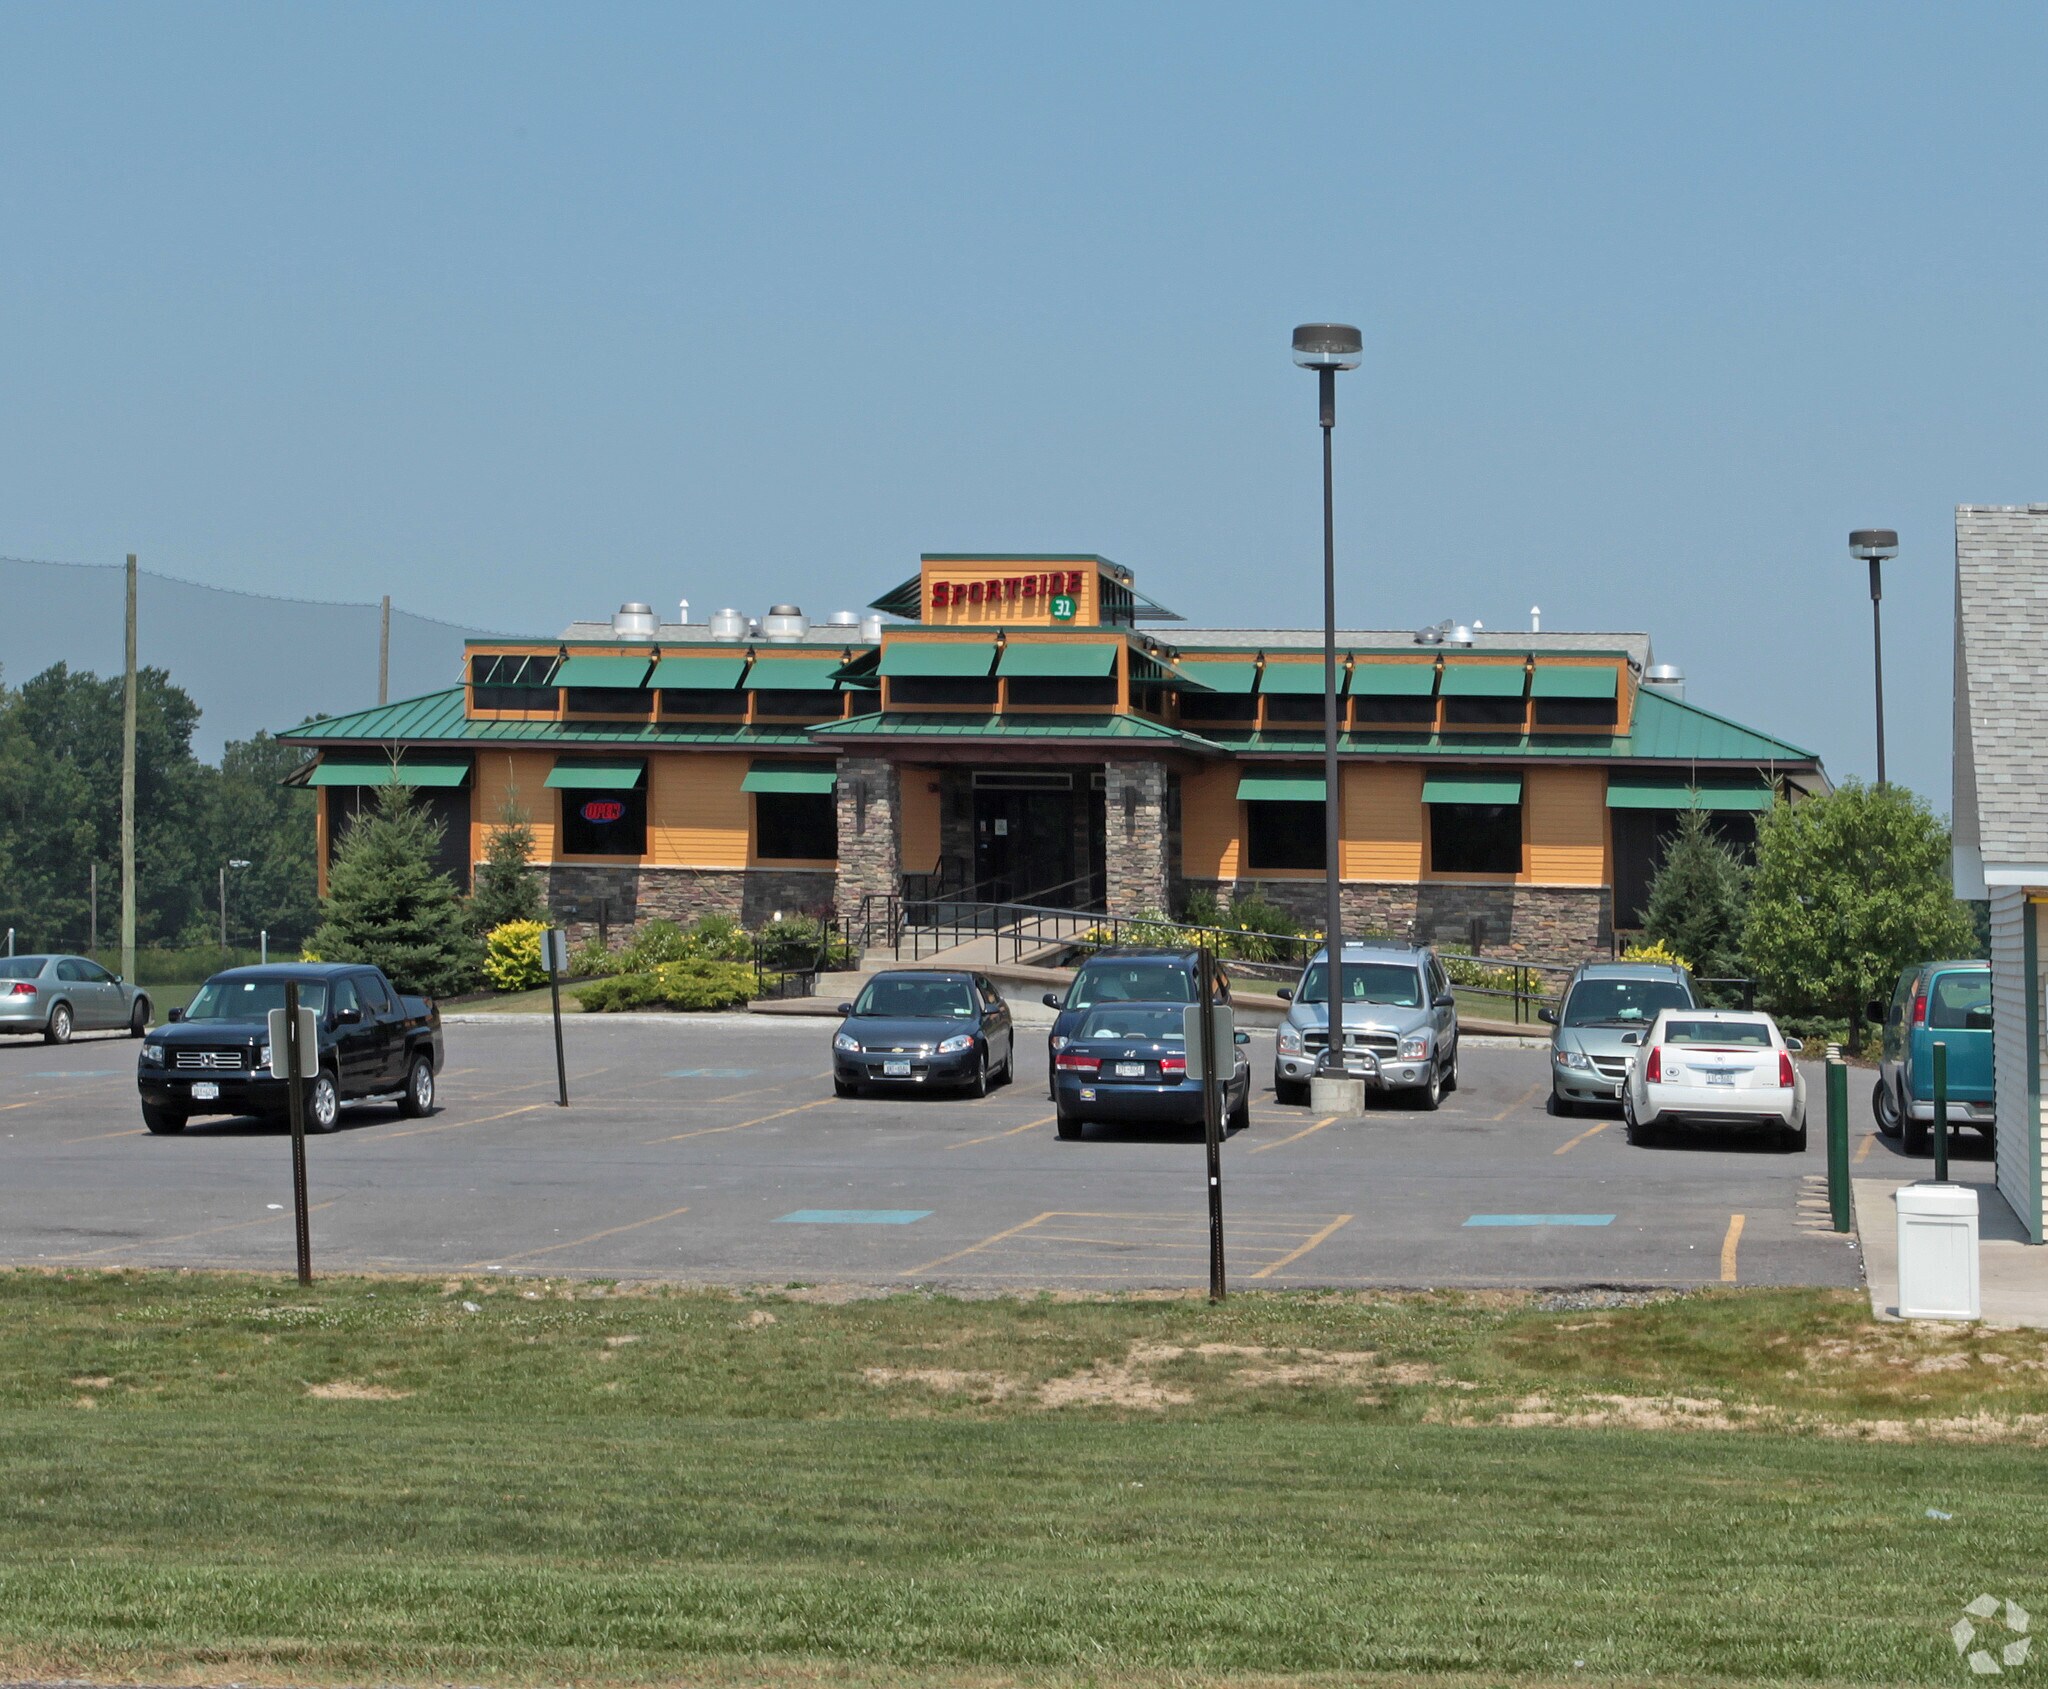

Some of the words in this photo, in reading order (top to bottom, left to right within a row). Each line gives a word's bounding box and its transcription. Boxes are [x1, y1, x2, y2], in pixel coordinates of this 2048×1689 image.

[931, 570, 1083, 608] SPORTSIDE
[1053, 599, 1072, 617] 31
[585, 802, 621, 820] OPEN
